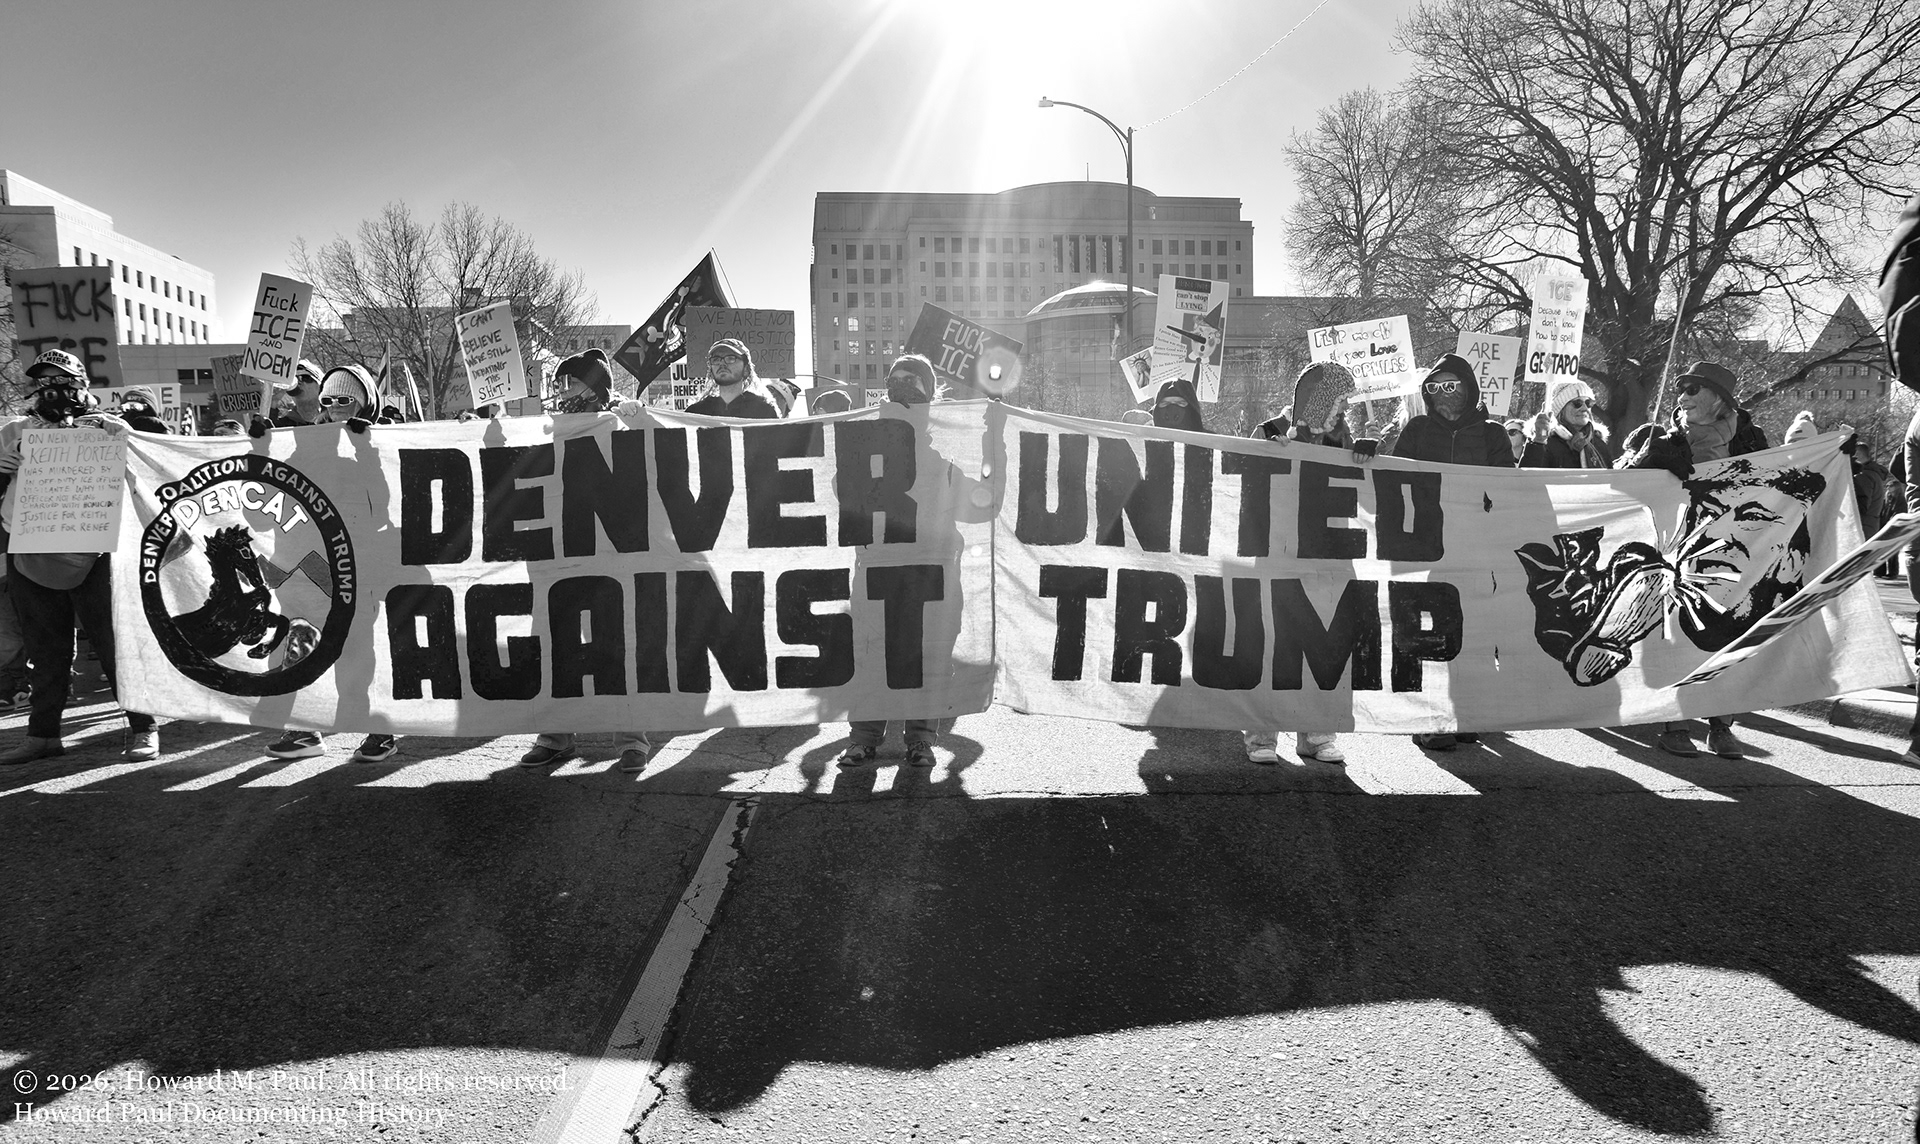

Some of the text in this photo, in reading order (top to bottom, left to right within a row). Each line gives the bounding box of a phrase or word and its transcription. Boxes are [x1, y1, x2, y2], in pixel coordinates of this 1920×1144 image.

[262, 286, 298, 312] Fuck
[1549, 279, 1574, 301] ICE
[15, 278, 114, 328] FUCK
[1180, 301, 1204, 310] LYING
[1538, 302, 1561, 316] because
[251, 311, 301, 342] ICE
[457, 316, 469, 335] I
[696, 311, 793, 326] WE ARE NOT
[1562, 318, 1576, 328] know
[462, 329, 502, 355] BELIEVE
[713, 330, 793, 345] DOMESTIC
[942, 318, 991, 355] FUCK
[1536, 330, 1548, 340] how
[1551, 330, 1558, 341] to
[487, 344, 512, 359] STILL
[1345, 350, 1366, 364] you
[1370, 343, 1398, 357] Love
[1467, 342, 1501, 360] ARE
[244, 347, 292, 378] NOEM
[471, 361, 507, 380] DEBATING
[933, 344, 974, 380] ICE
[222, 373, 238, 391] MY
[485, 373, 501, 385] THIS
[1479, 377, 1509, 391] EAT
[674, 385, 697, 396] RENEE
[220, 391, 261, 412] CRUSHED
[28, 433, 44, 444] ON
[47, 432, 68, 444] NEW
[29, 445, 122, 464] KEITH PORTER
[24, 465, 113, 476] WAS MURDERED BY
[81, 476, 92, 484] ICE
[76, 485, 94, 494] WHY
[400, 417, 1445, 566] DENVER UNITED
[170, 480, 309, 534] DENCAT
[20, 511, 108, 523] JUSTICE FOR KEITH
[18, 522, 110, 535] JUSTICE FOR RENEE
[143, 511, 173, 584] DENVER
[261, 462, 335, 521] AGAINST
[331, 530, 352, 605] TRUMP
[384, 565, 1464, 700] AGAINST TRUMP
